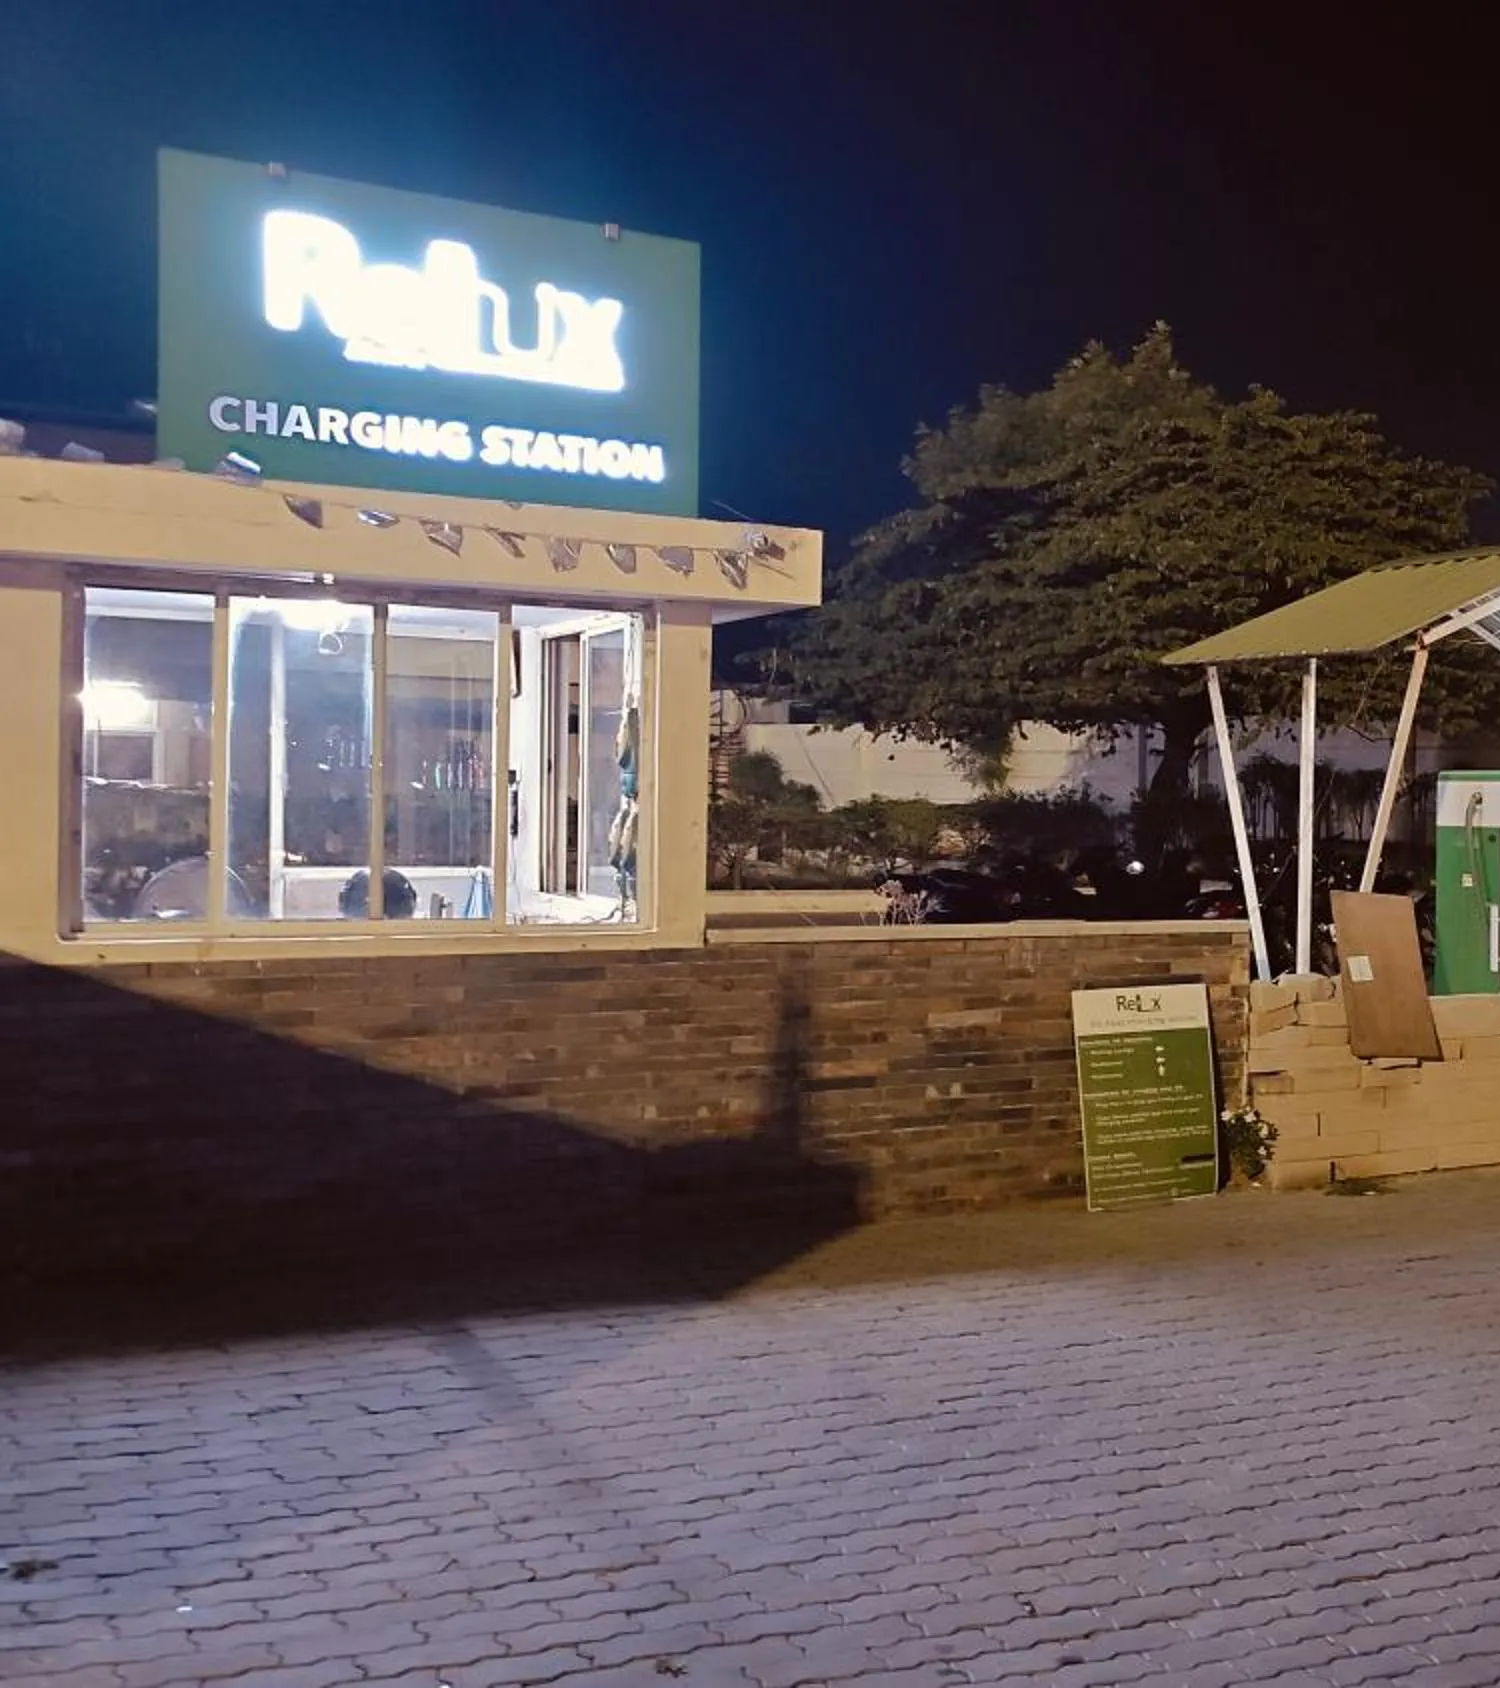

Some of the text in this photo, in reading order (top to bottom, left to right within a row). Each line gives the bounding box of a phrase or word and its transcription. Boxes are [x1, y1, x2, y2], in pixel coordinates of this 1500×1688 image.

[209, 396, 665, 483] CHARGING STATION
[1116, 994, 1162, 1012] ReLx
